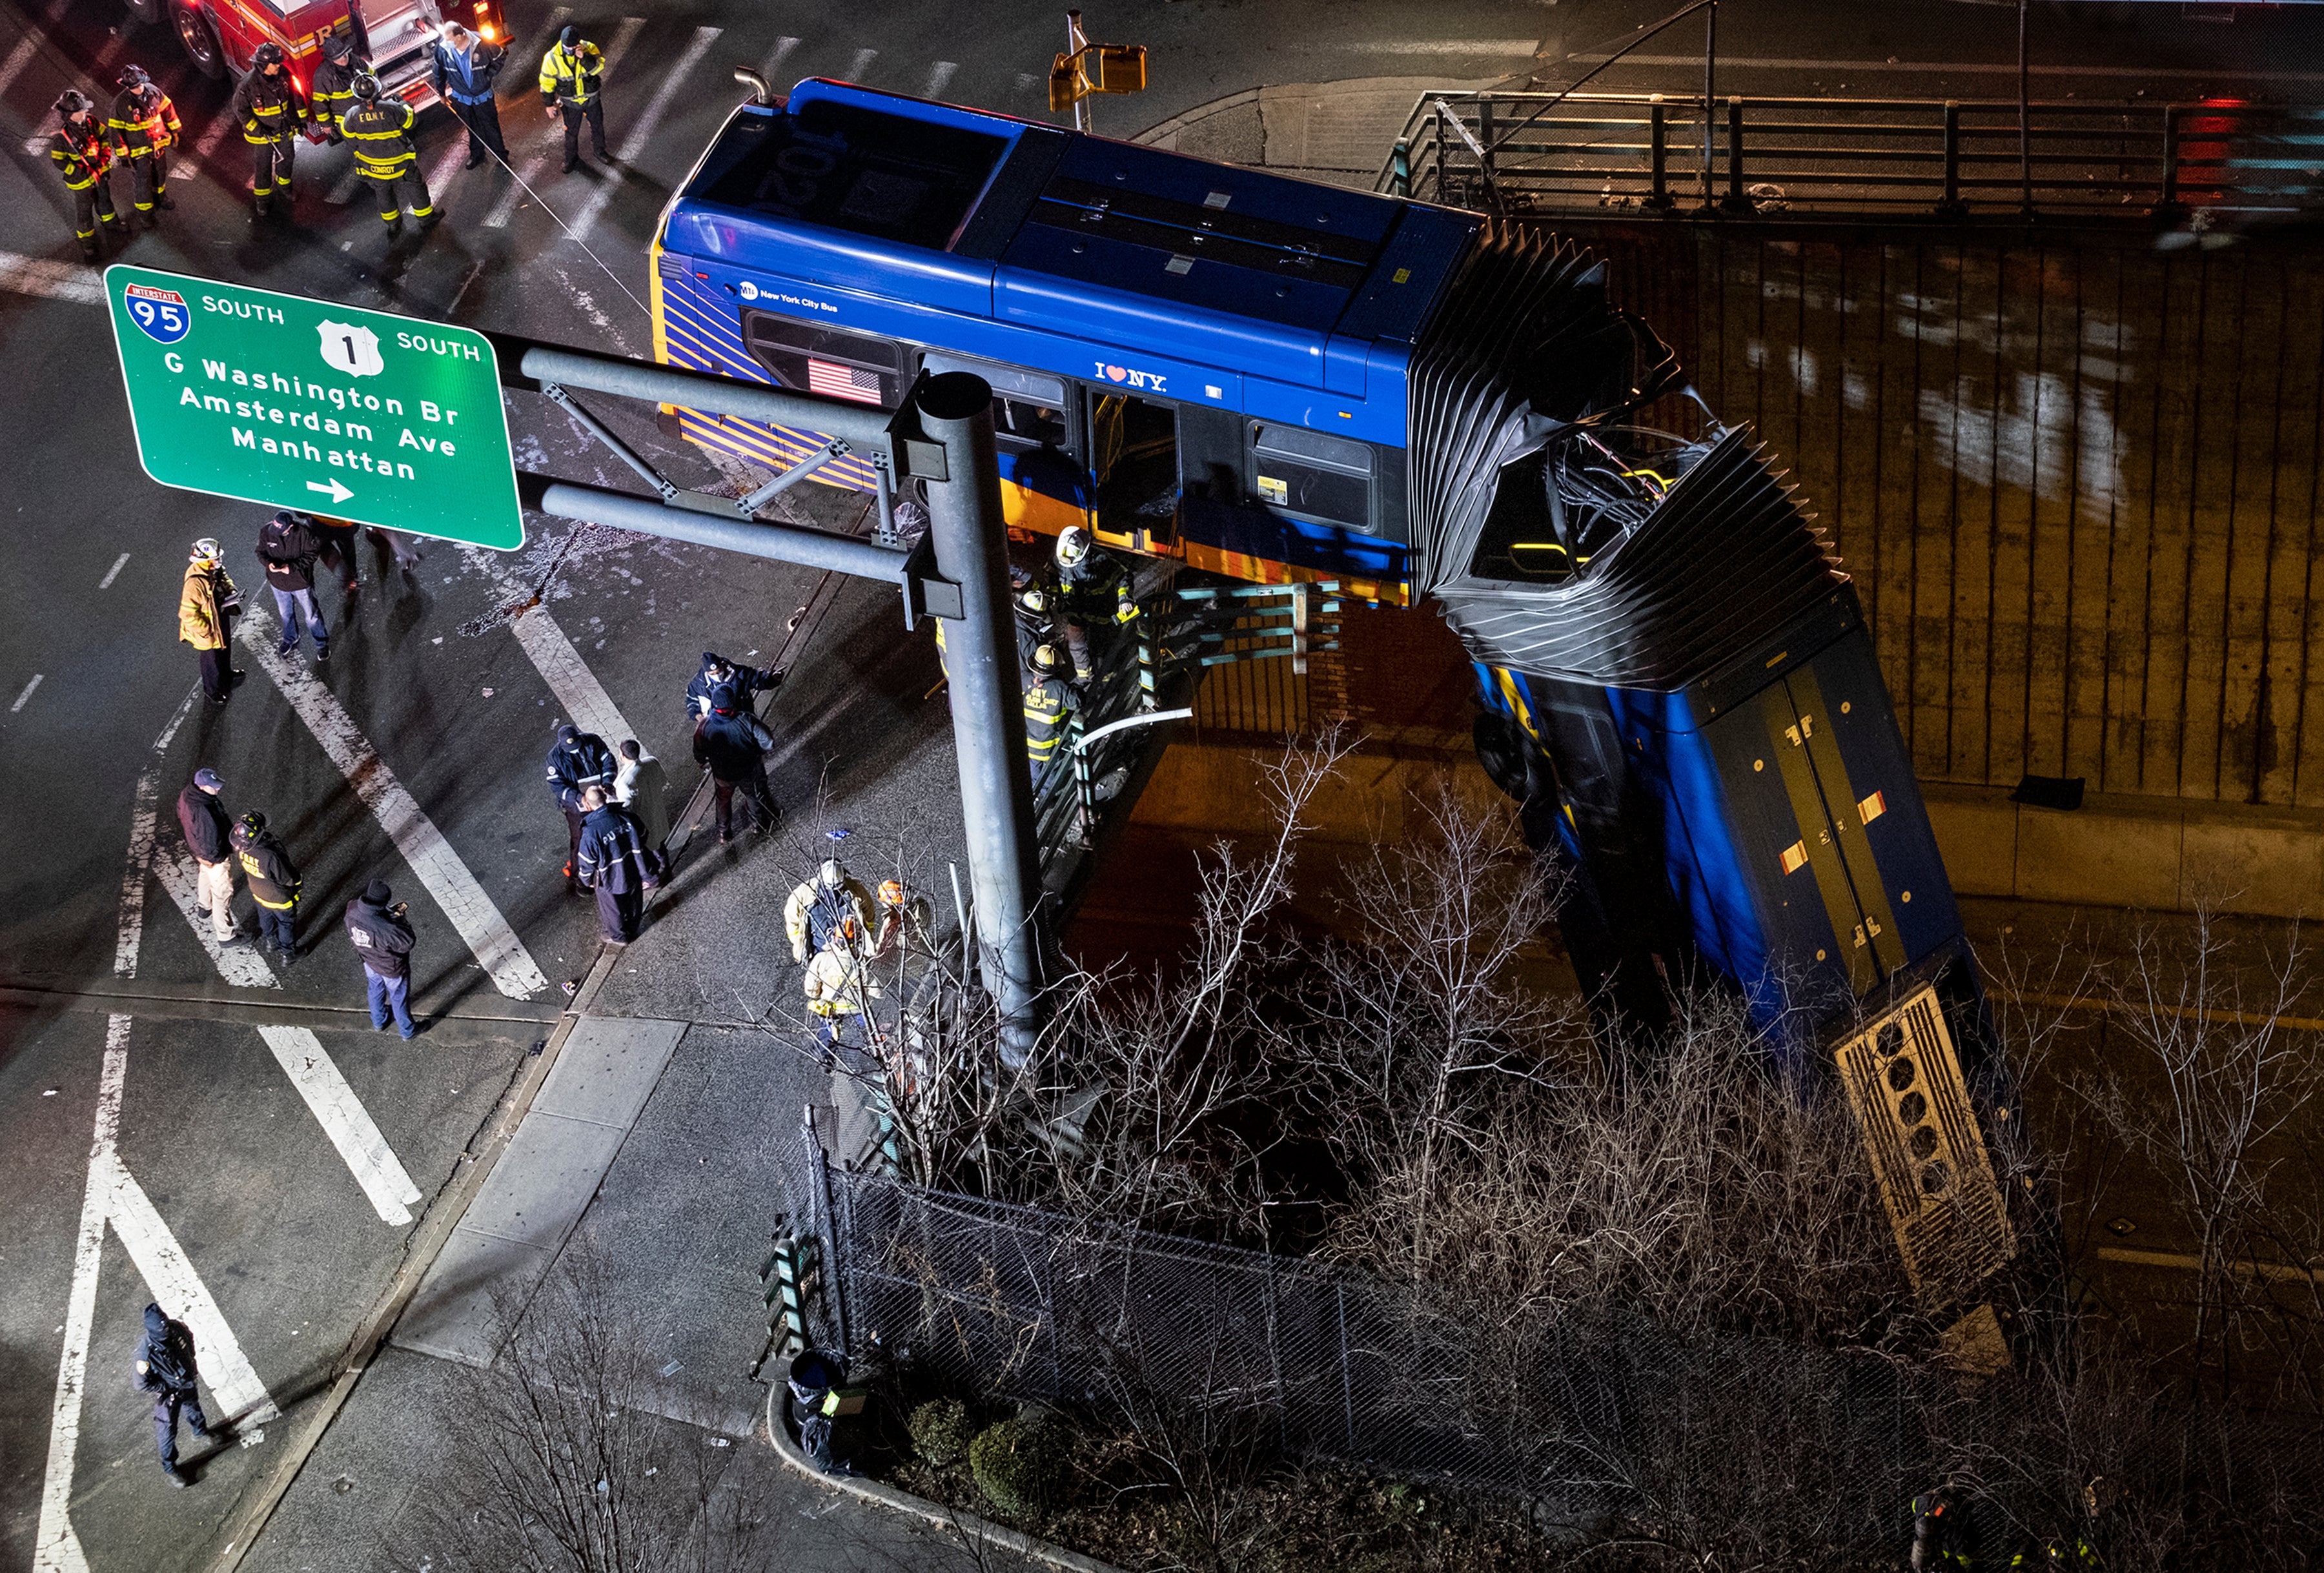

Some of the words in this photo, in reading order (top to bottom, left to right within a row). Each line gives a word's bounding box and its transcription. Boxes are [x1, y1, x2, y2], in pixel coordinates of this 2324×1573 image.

[370, 165, 394, 174] CONROY
[132, 287, 177, 302] INTERSTATE
[760, 289, 780, 300] New
[780, 294, 800, 305] York
[801, 298, 819, 310] City
[821, 301, 838, 313] Bus
[134, 301, 182, 332] 95
[202, 295, 284, 325] SOUTH
[341, 336, 356, 365] 1
[397, 332, 480, 361] SOUTH
[1095, 361, 1106, 379] I
[165, 352, 184, 373] G
[201, 358, 403, 416] Washington
[420, 400, 458, 425] Br
[179, 386, 373, 441] Amsterdam
[398, 428, 456, 456] Ave
[231, 426, 415, 480] Manhattan
